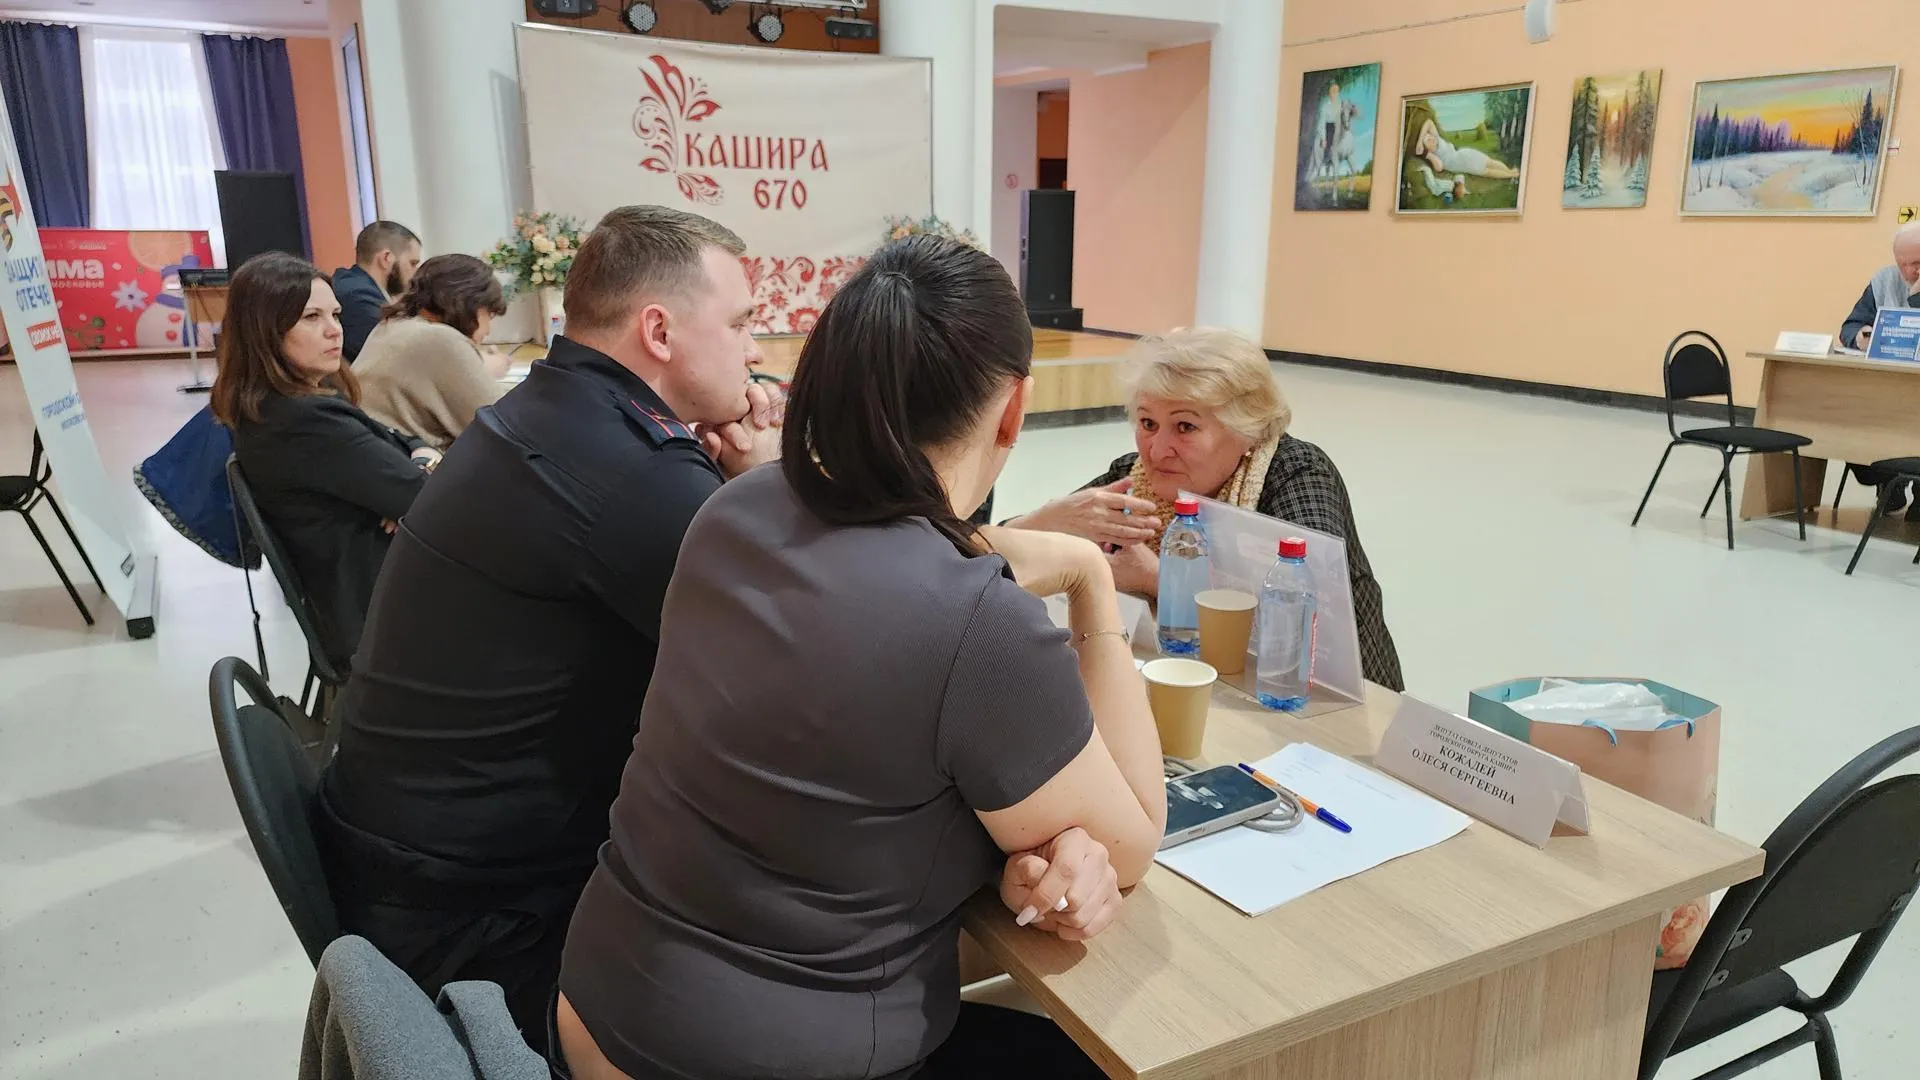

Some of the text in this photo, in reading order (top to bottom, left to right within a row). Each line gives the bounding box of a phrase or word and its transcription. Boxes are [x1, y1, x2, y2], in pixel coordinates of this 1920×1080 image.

[685, 132, 830, 171] КАШИРА
[754, 179, 808, 210] 670
[1429, 730, 1516, 774] ГОРОДСКОГО ОКРУГА КАШИРА
[1434, 724, 1518, 766] ДЕПУТАТ СОВЕТА ДЕПУТАТОВ
[1439, 745, 1496, 779] КОЖАДЕЙ
[1411, 748, 1515, 805] ОЛЕСЯ СЕРГЕЕВНА
